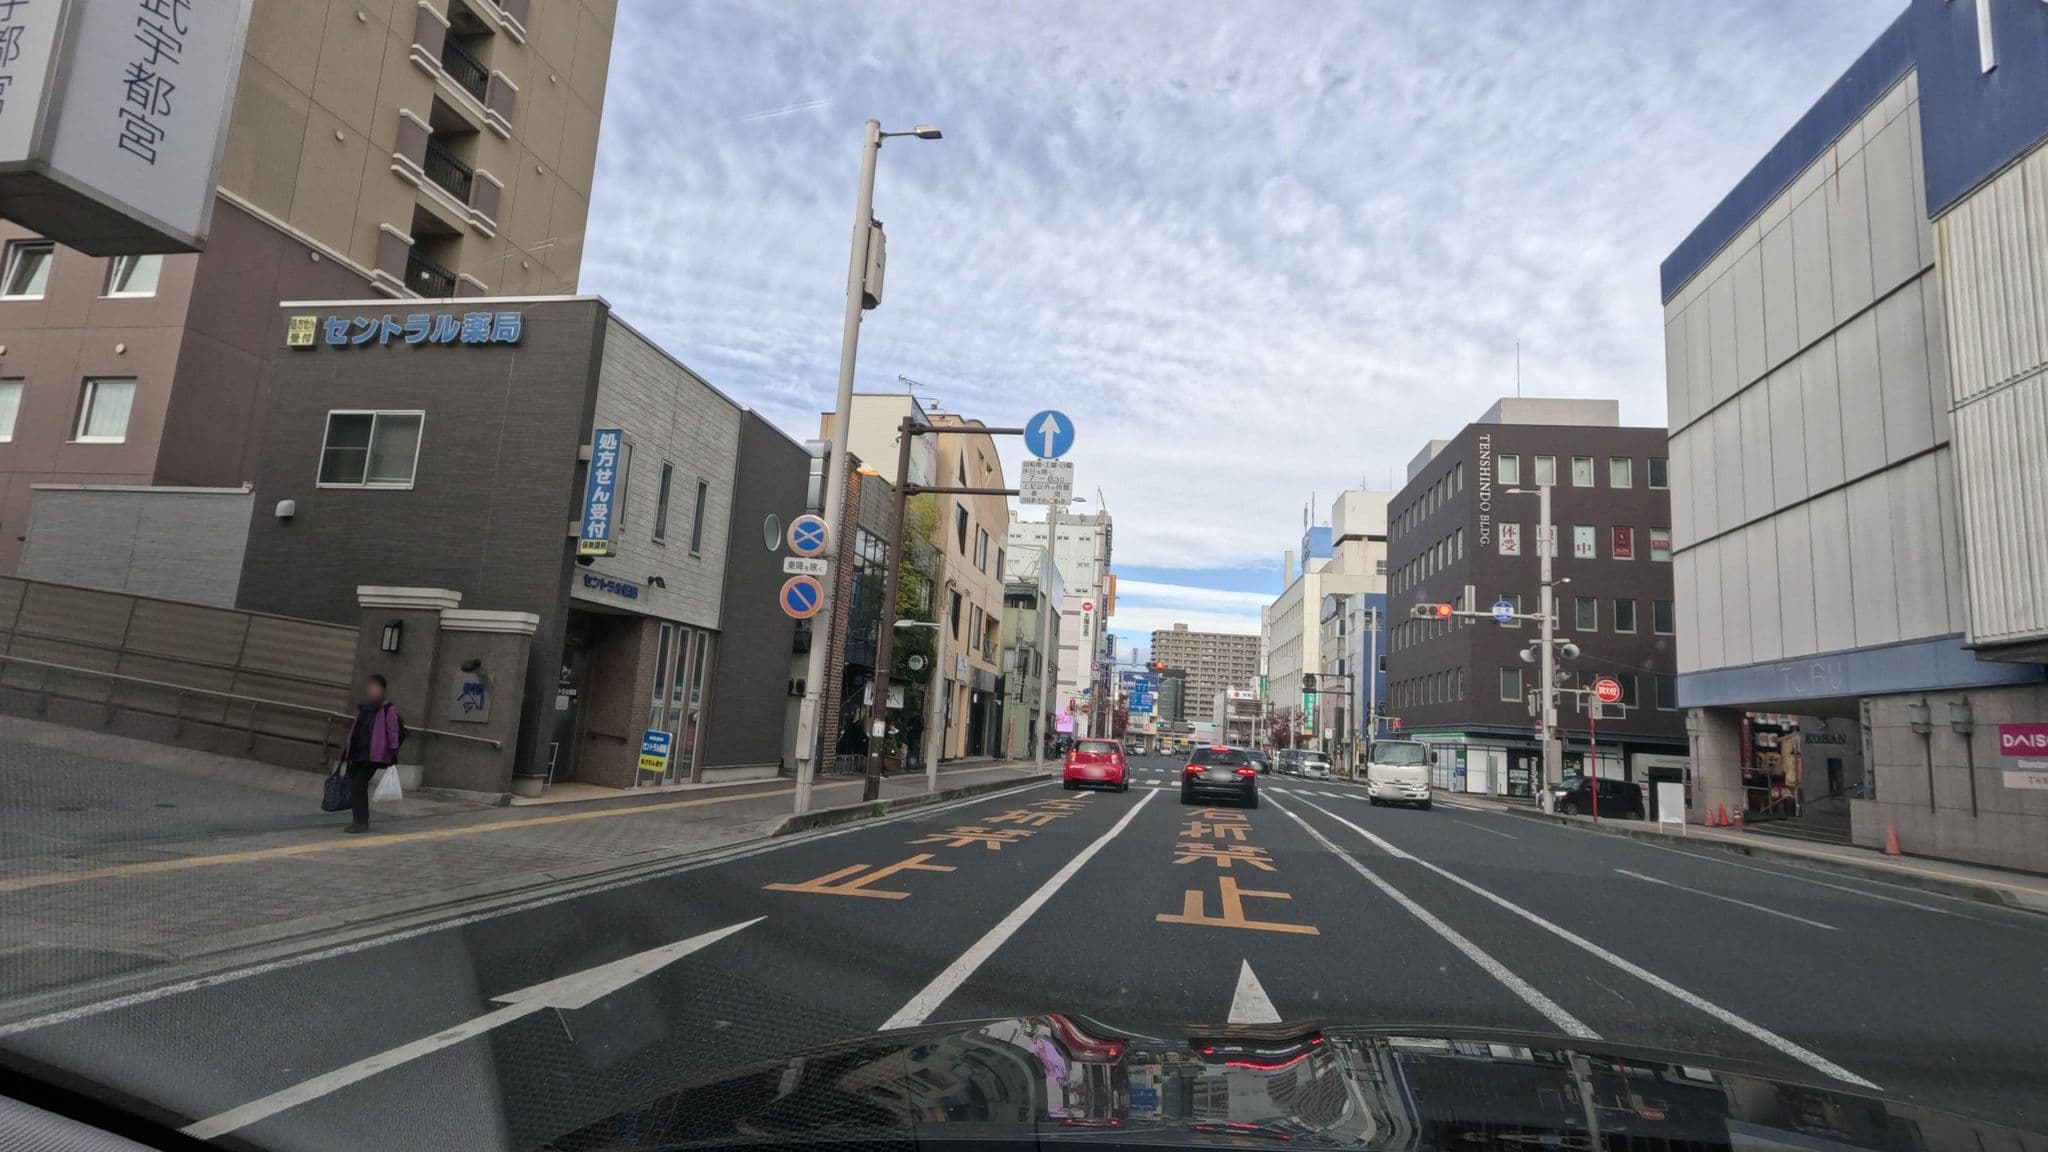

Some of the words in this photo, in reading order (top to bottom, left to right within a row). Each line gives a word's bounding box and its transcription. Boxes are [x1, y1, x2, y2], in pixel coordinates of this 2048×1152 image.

[323, 311, 522, 345] セントラル薬局
[587, 432, 618, 539] 処方せん受付
[1479, 434, 1491, 512] TENSHINDO
[1479, 514, 1490, 548] BLDG.
[2002, 734, 2048, 748] DAIS
[1155, 808, 1321, 936] 右折禁止
